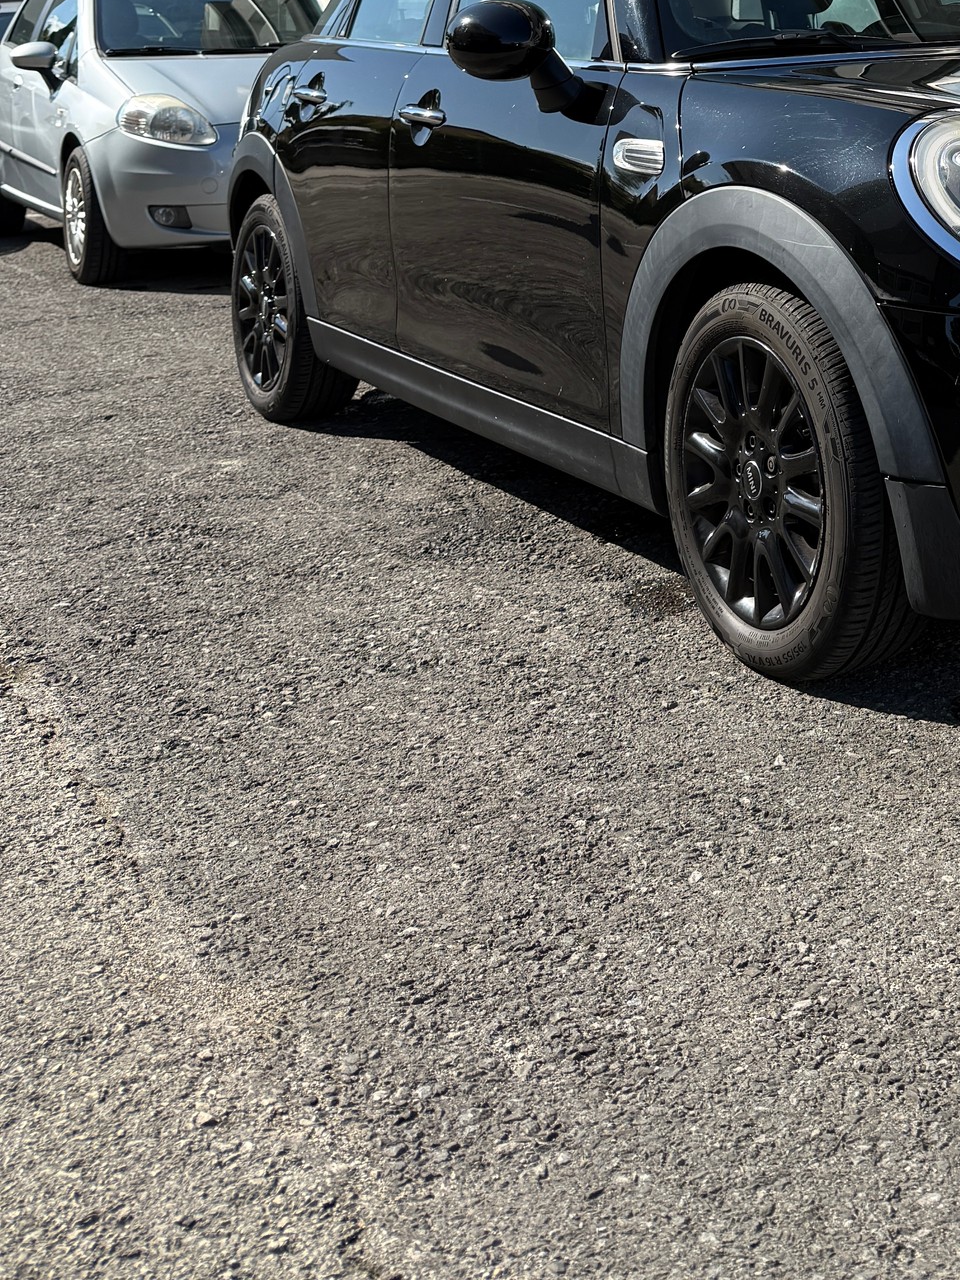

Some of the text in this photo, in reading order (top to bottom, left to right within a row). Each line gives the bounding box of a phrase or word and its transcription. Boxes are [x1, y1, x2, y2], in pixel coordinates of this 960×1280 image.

[758, 308, 827, 410] BRAVURIS 5 HM
[746, 466, 757, 494] MINI
[782, 640, 807, 663] 195/55
